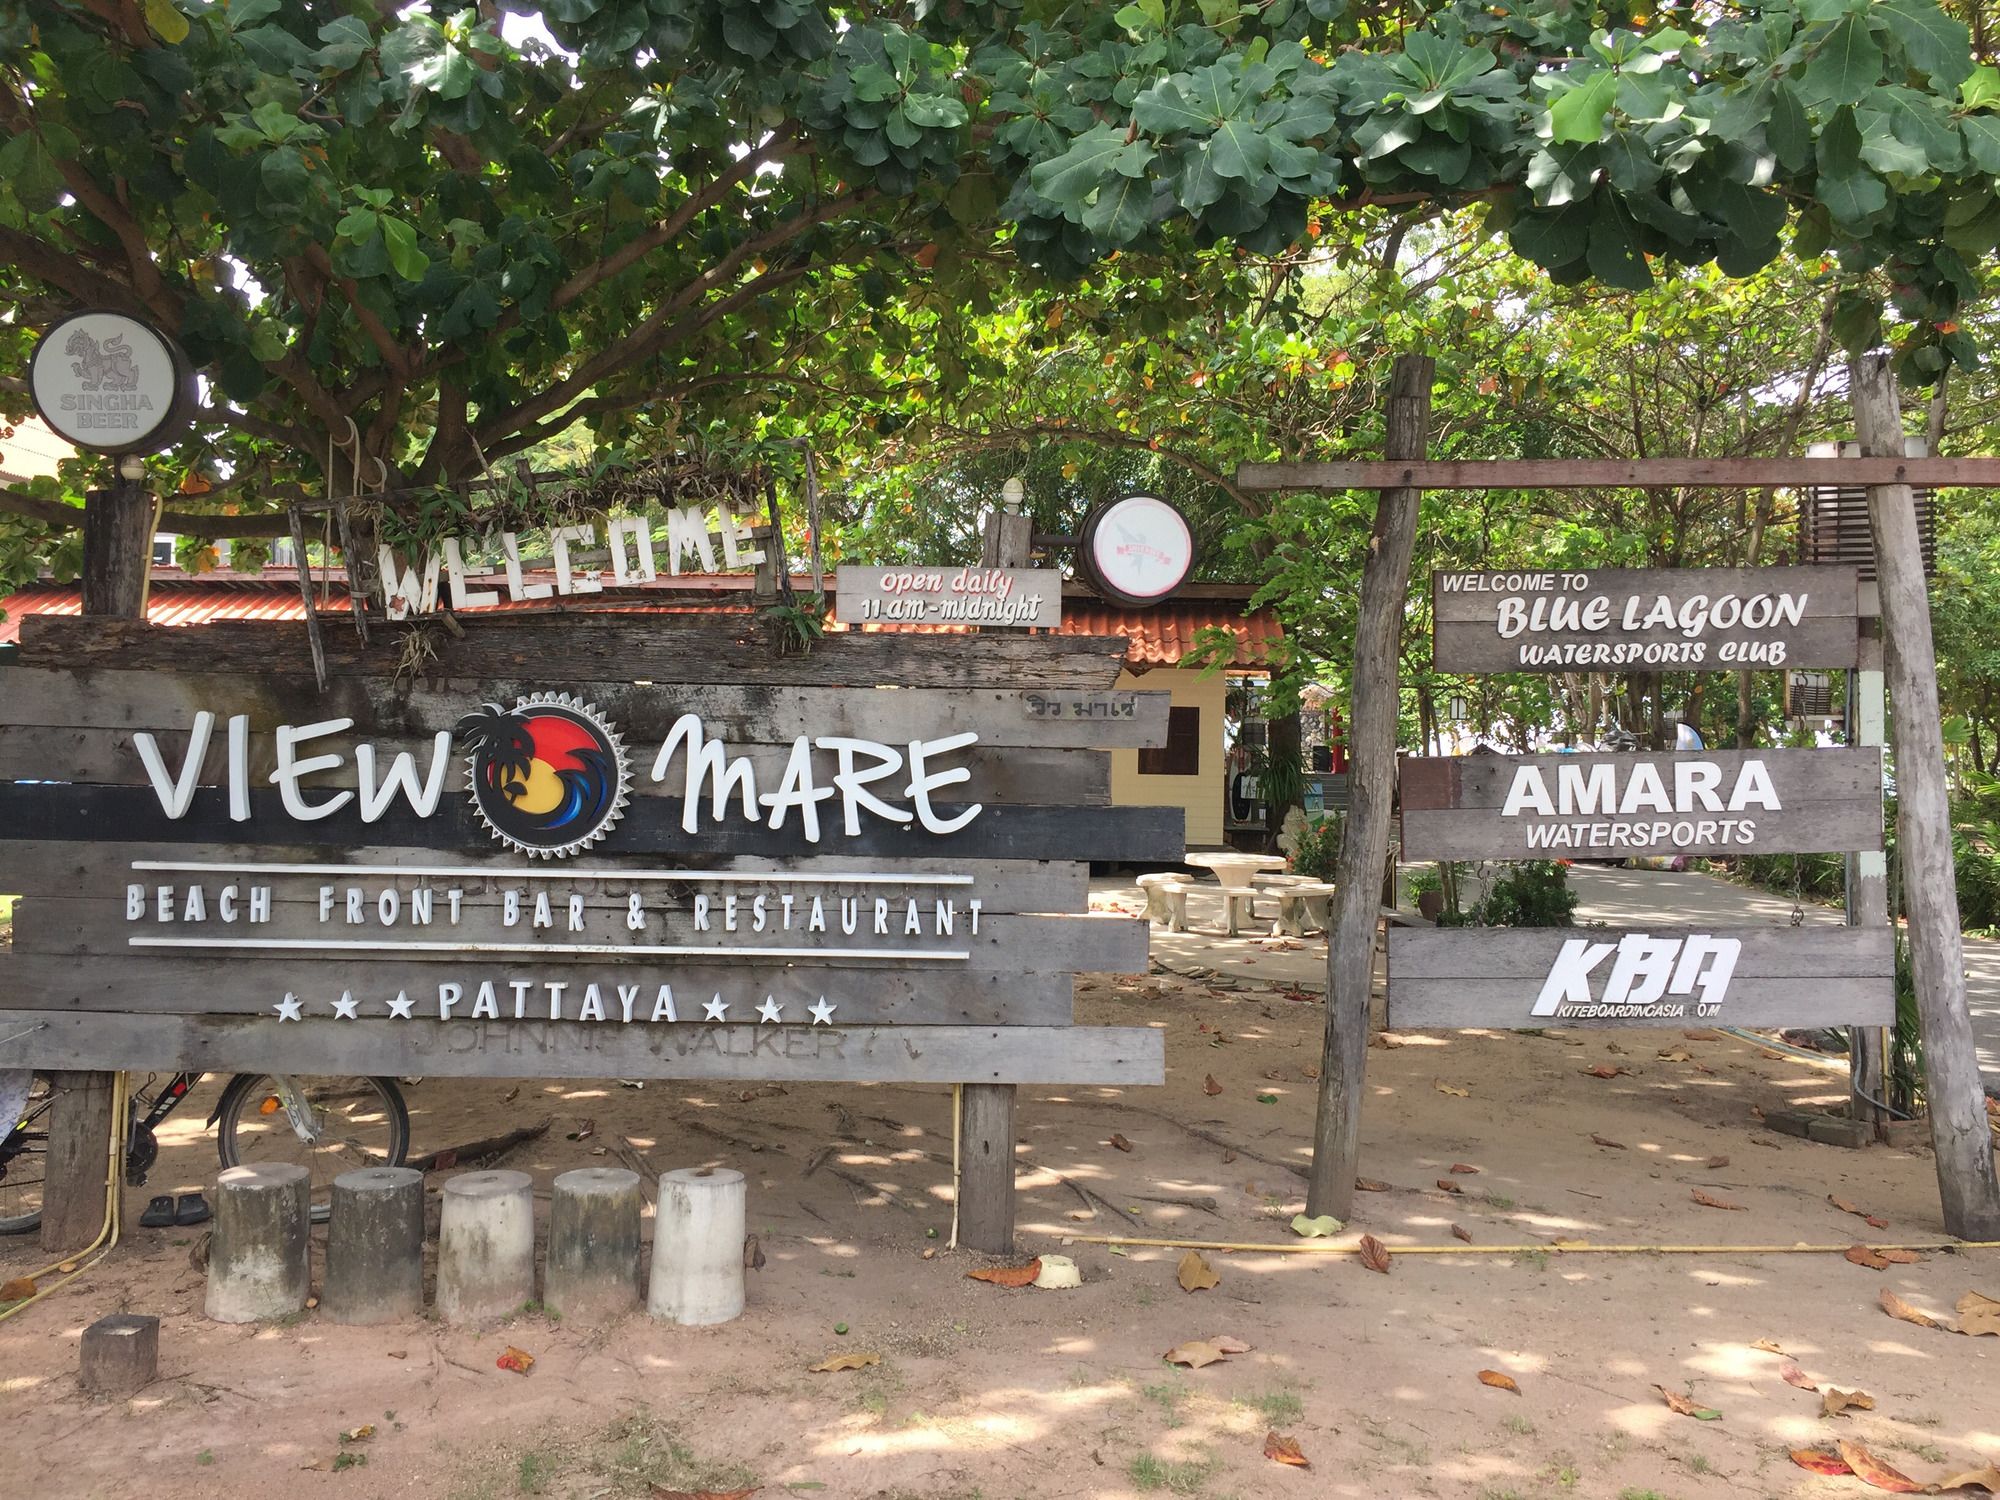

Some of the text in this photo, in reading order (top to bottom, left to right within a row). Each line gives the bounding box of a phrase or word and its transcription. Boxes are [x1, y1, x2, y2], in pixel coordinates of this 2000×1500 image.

[60, 394, 153, 411] SINGHA
[77, 412, 138, 429] BEER
[378, 500, 767, 621] WELCOME
[880, 567, 1014, 600] open daily
[1442, 573, 1589, 593] WELCOME TO
[1497, 593, 1808, 639] BLUE LAGOON
[1519, 641, 1788, 666] WATERSPORTS CLUB
[132, 710, 983, 844] VIEW MARE
[1501, 760, 1782, 817] AMARA
[1526, 819, 1758, 849] WATERSPORTS
[126, 883, 272, 923] BEACH
[319, 885, 465, 926] FRONT
[504, 890, 586, 932] BAR
[627, 892, 646, 931] &
[694, 894, 983, 936] RESTAURANT
[1530, 933, 1743, 1016] KBA
[439, 981, 678, 1023] PATTAYA
